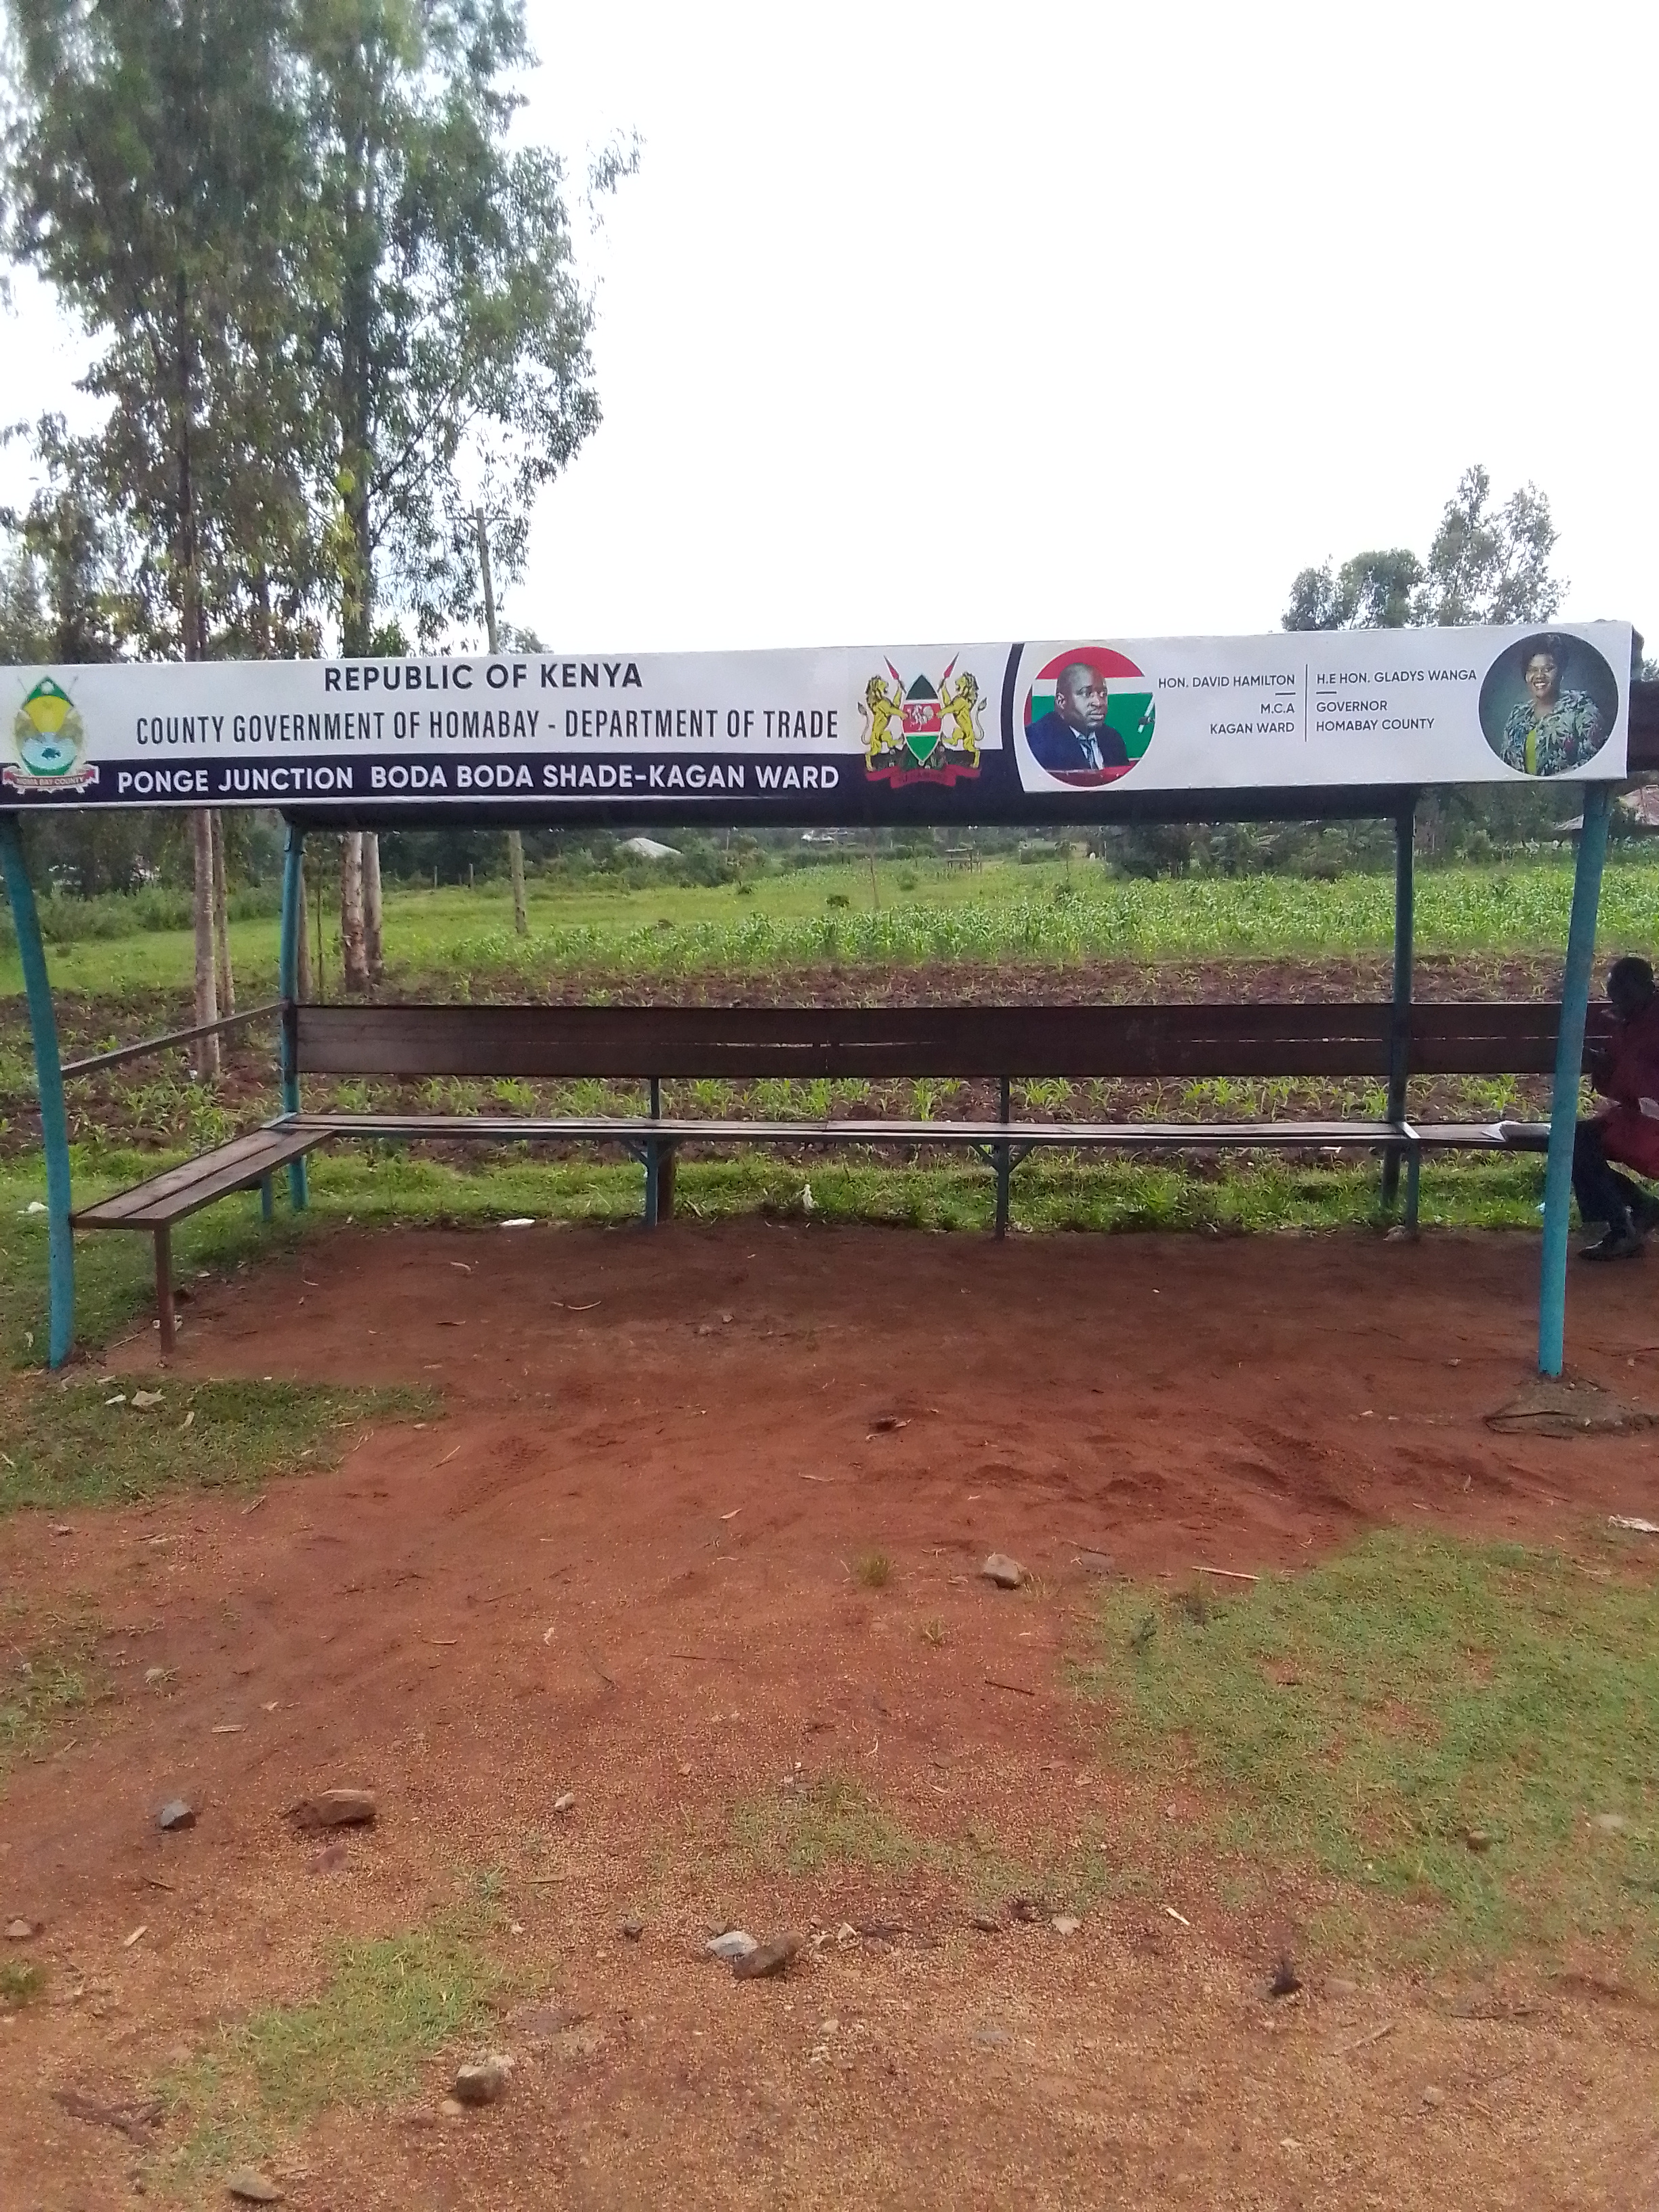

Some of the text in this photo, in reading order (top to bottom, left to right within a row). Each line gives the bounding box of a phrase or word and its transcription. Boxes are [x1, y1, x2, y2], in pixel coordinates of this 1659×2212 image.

[325, 662, 642, 692] REPUBLIC OF KENYA
[1158, 674, 1295, 689] HON. DAVID HAMILTON
[1317, 670, 1477, 684] H.E HON. GLADYS WANGA
[1261, 703, 1295, 714] M.C.A
[1316, 700, 1387, 712] GOVERNOR
[137, 716, 224, 745] COUNTY
[233, 712, 385, 743] GOVERNMENT
[394, 711, 420, 739] OF
[430, 710, 539, 739] HOMABAY
[566, 710, 718, 739] DEPARTMENT
[727, 710, 755, 738] OF
[762, 710, 838, 739] TRADE
[1210, 722, 1294, 735] KAGAN WARD
[1316, 718, 1435, 732] HOMABAY COUNTY
[117, 764, 839, 794] PONGE JUNCTION BODA BODA SHADE-KAGAN WARD
